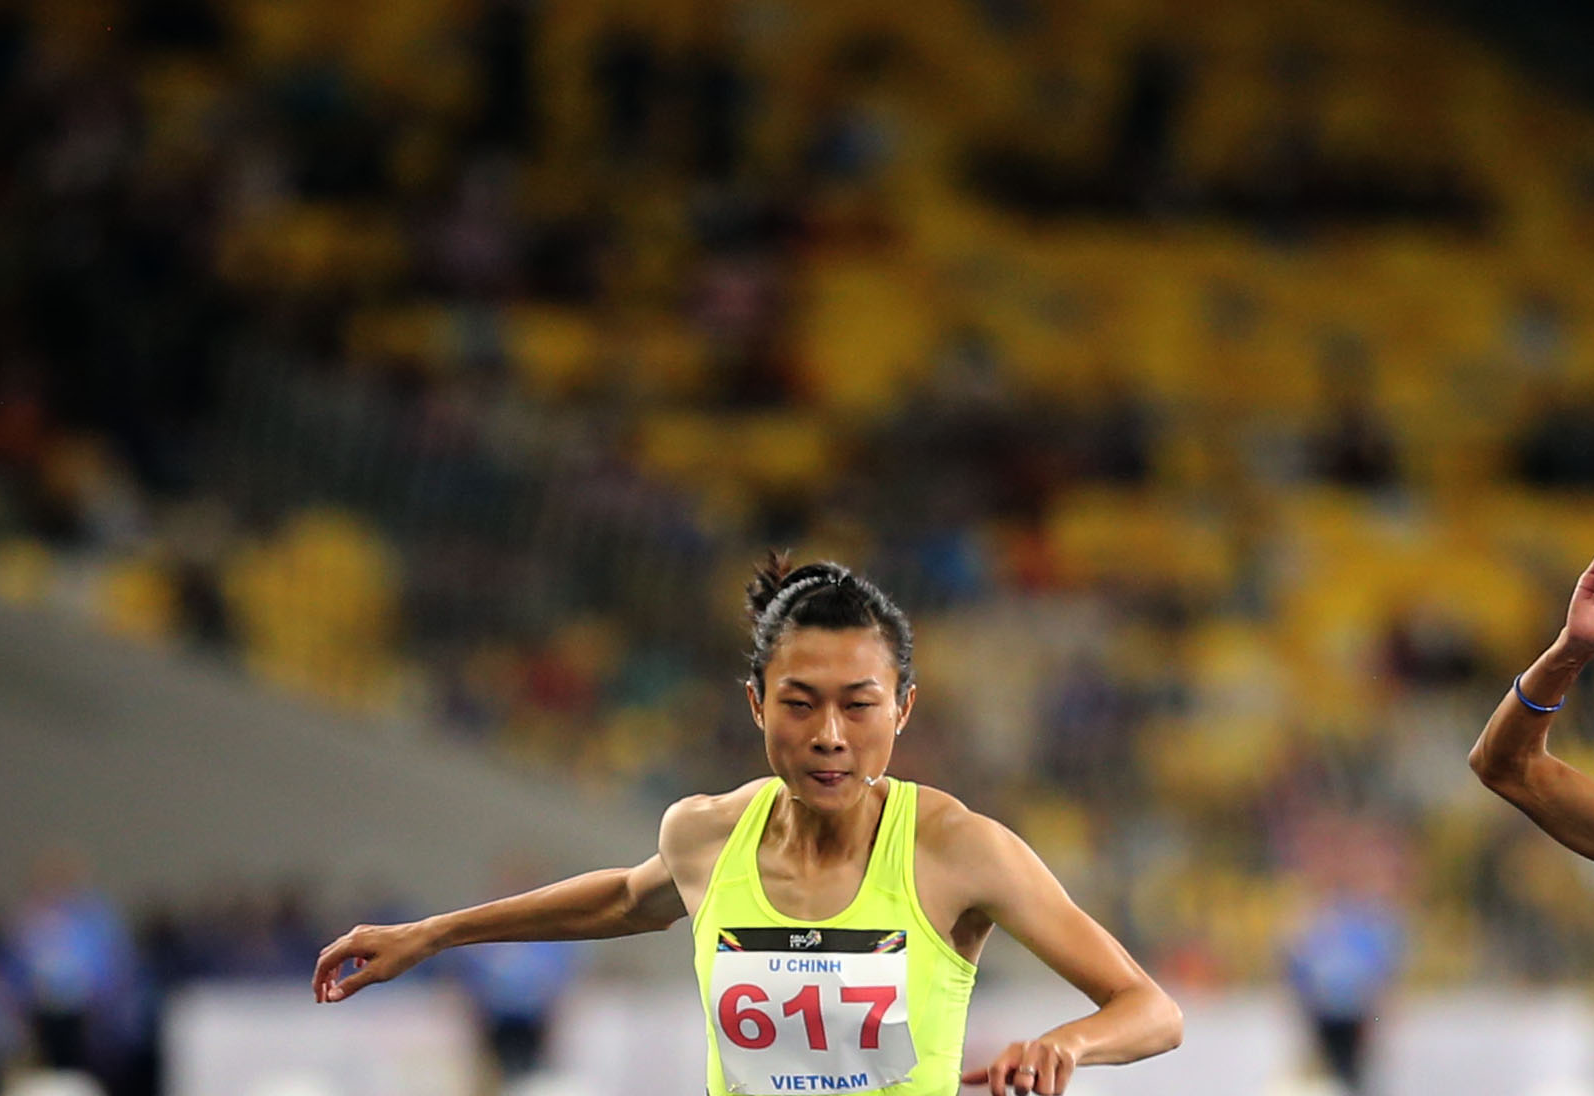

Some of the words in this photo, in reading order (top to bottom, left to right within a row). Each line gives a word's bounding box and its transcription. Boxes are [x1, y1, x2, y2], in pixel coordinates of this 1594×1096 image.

[769, 959, 780, 972] U
[787, 959, 841, 973] CHINH
[718, 984, 897, 1051] 617
[770, 1073, 868, 1090] VIETNAM
